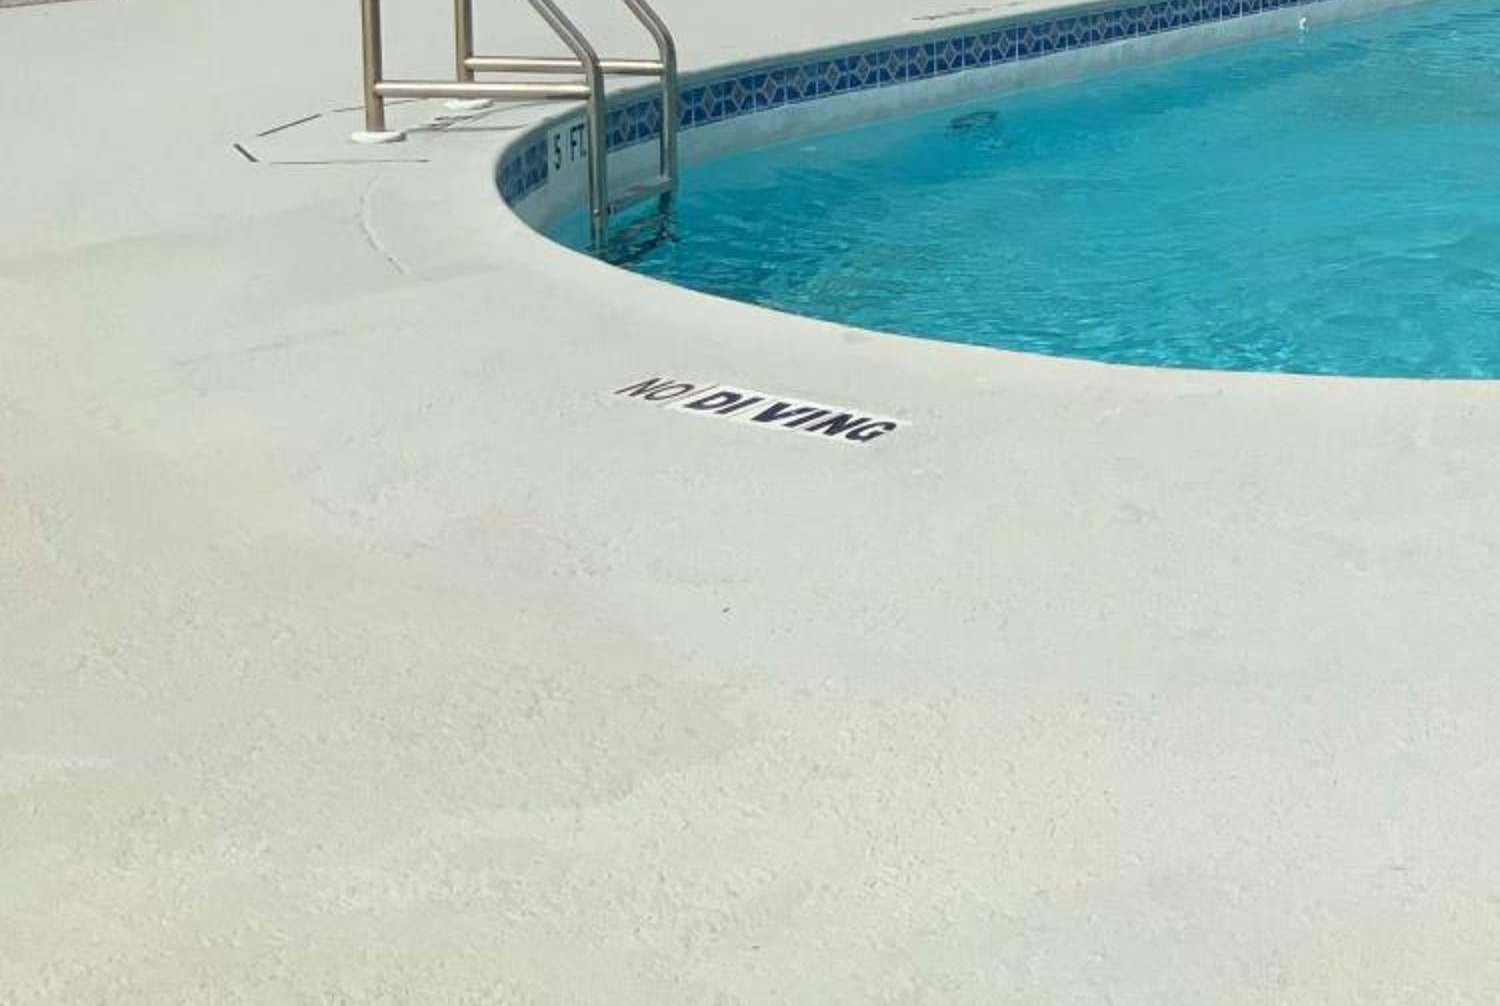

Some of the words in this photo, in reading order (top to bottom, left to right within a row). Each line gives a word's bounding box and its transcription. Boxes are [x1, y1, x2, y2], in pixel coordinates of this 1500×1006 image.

[553, 132, 562, 171] 5
[613, 376, 696, 402] NO
[683, 390, 898, 443] DIVING
